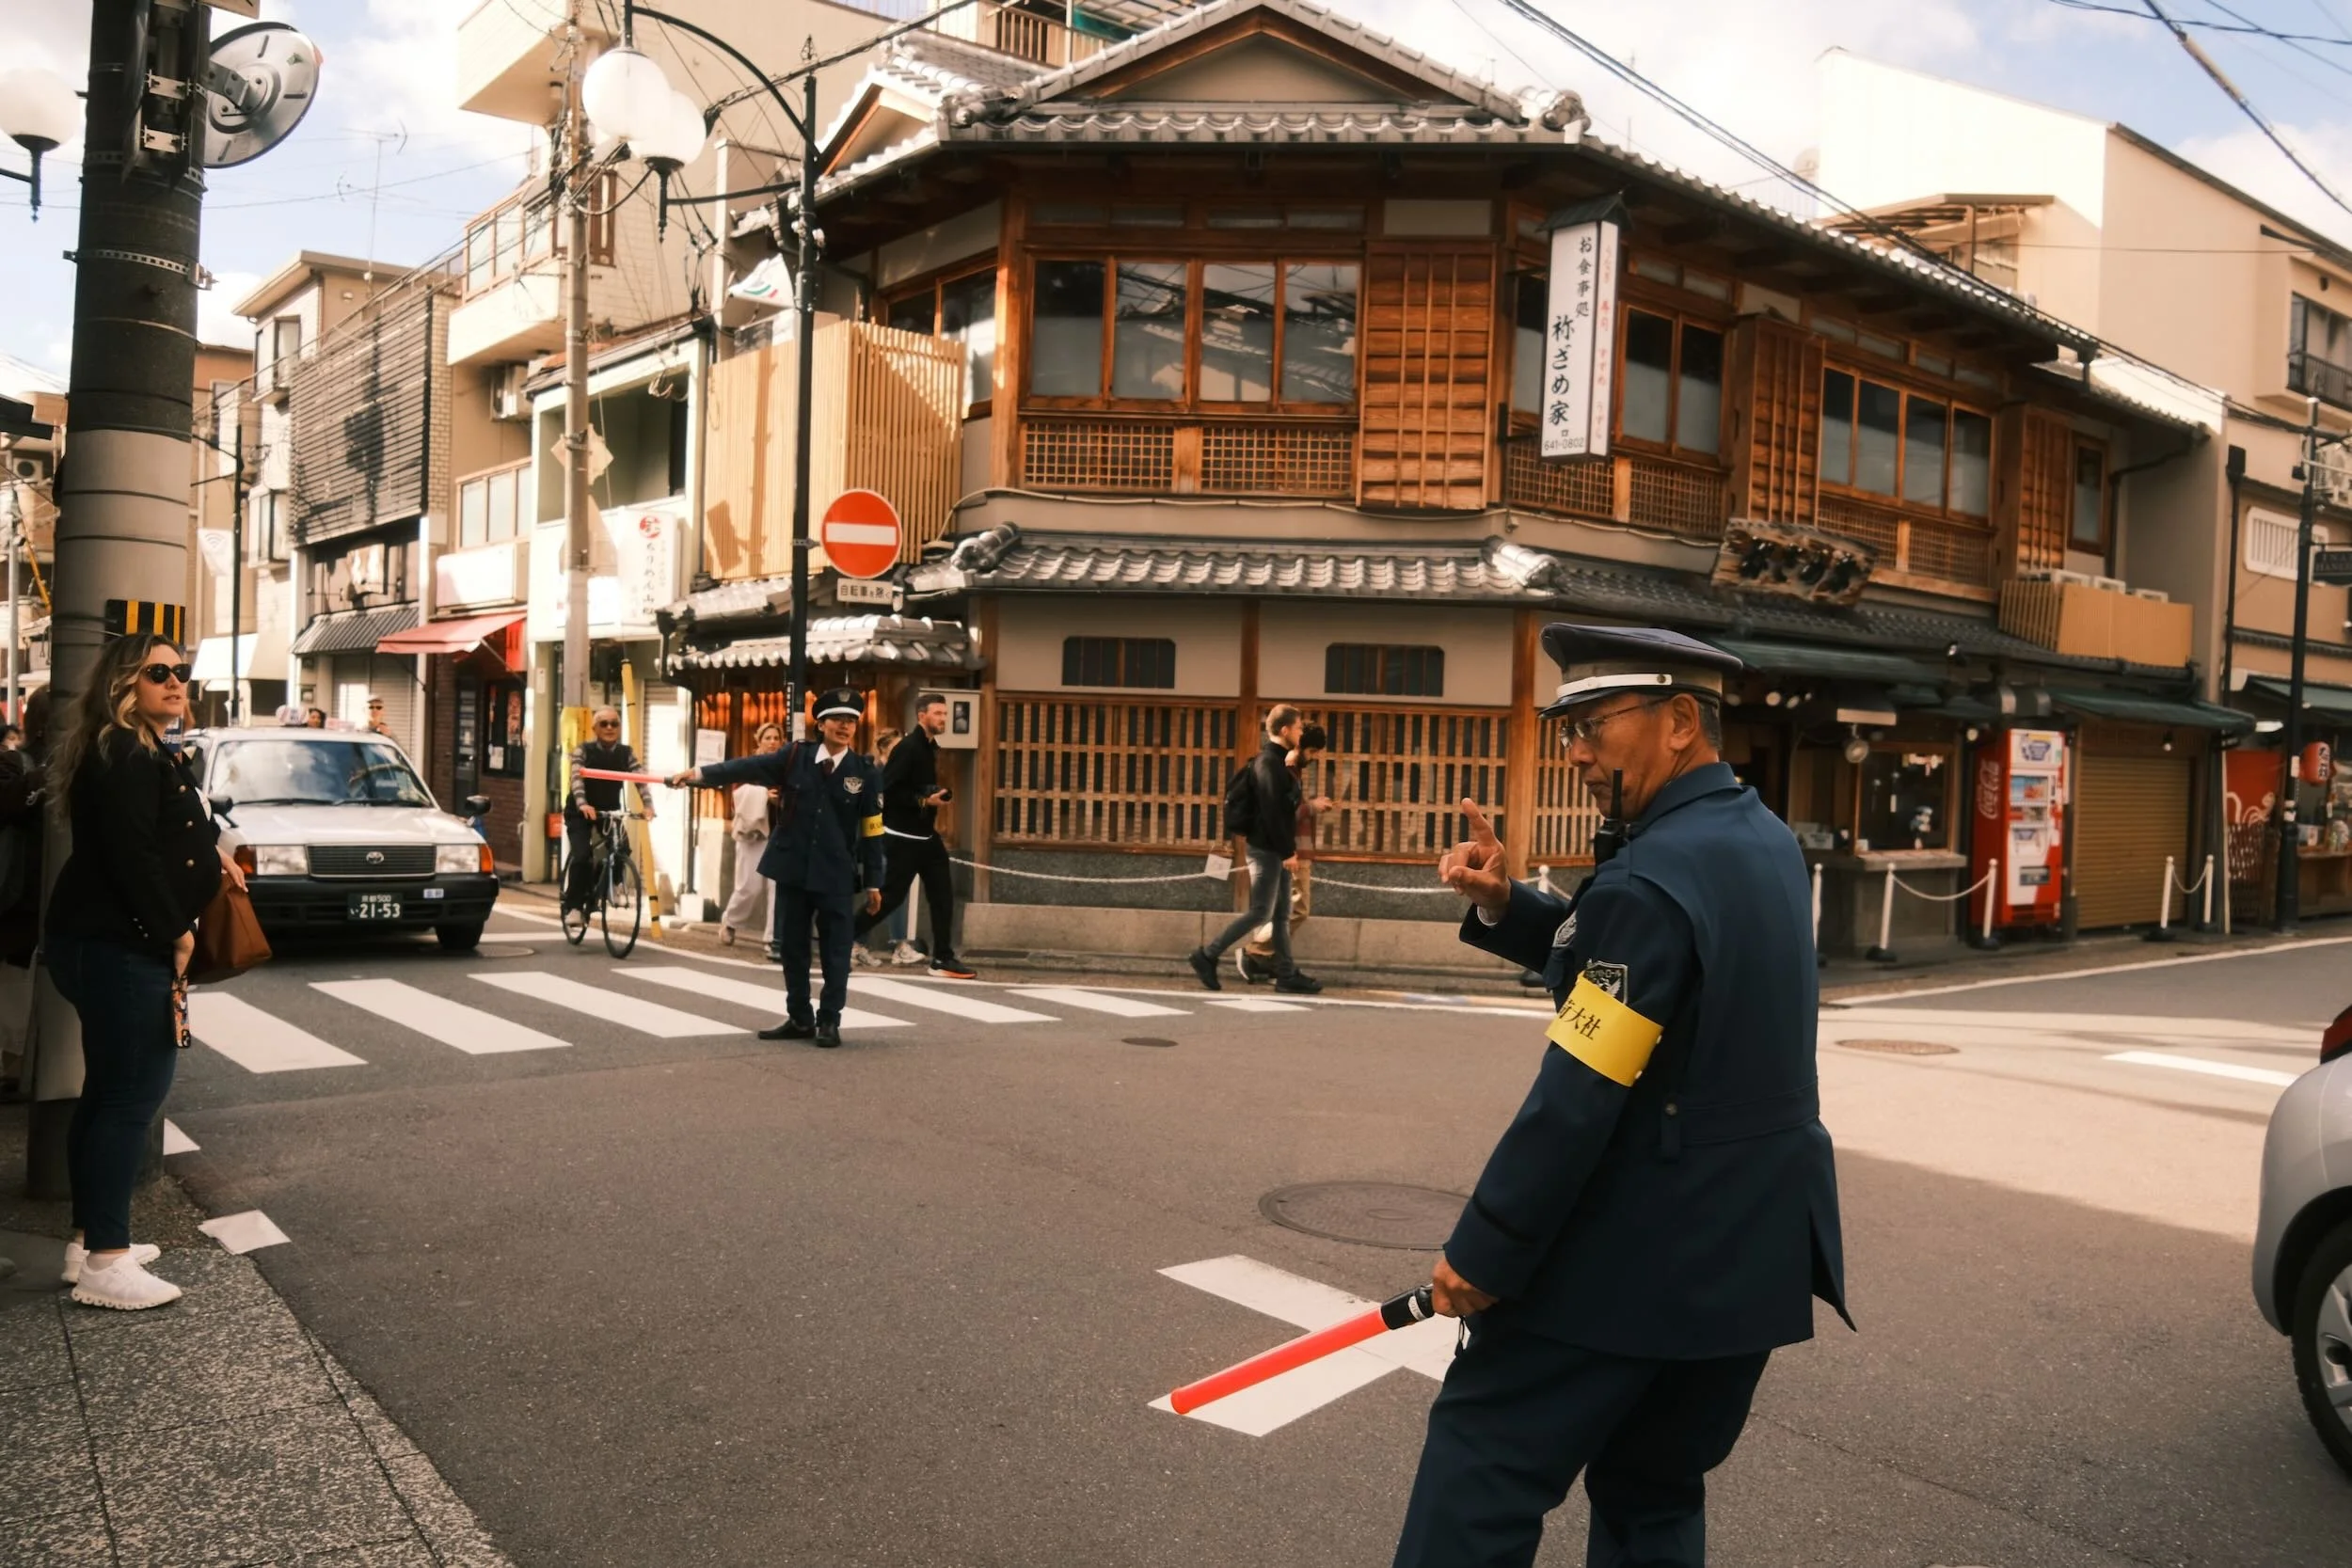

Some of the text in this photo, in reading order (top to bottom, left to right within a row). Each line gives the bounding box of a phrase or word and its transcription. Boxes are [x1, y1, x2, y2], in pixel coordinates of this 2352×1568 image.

[1576, 236, 1593, 317] お食事処
[359, 903, 401, 918] 21-53
